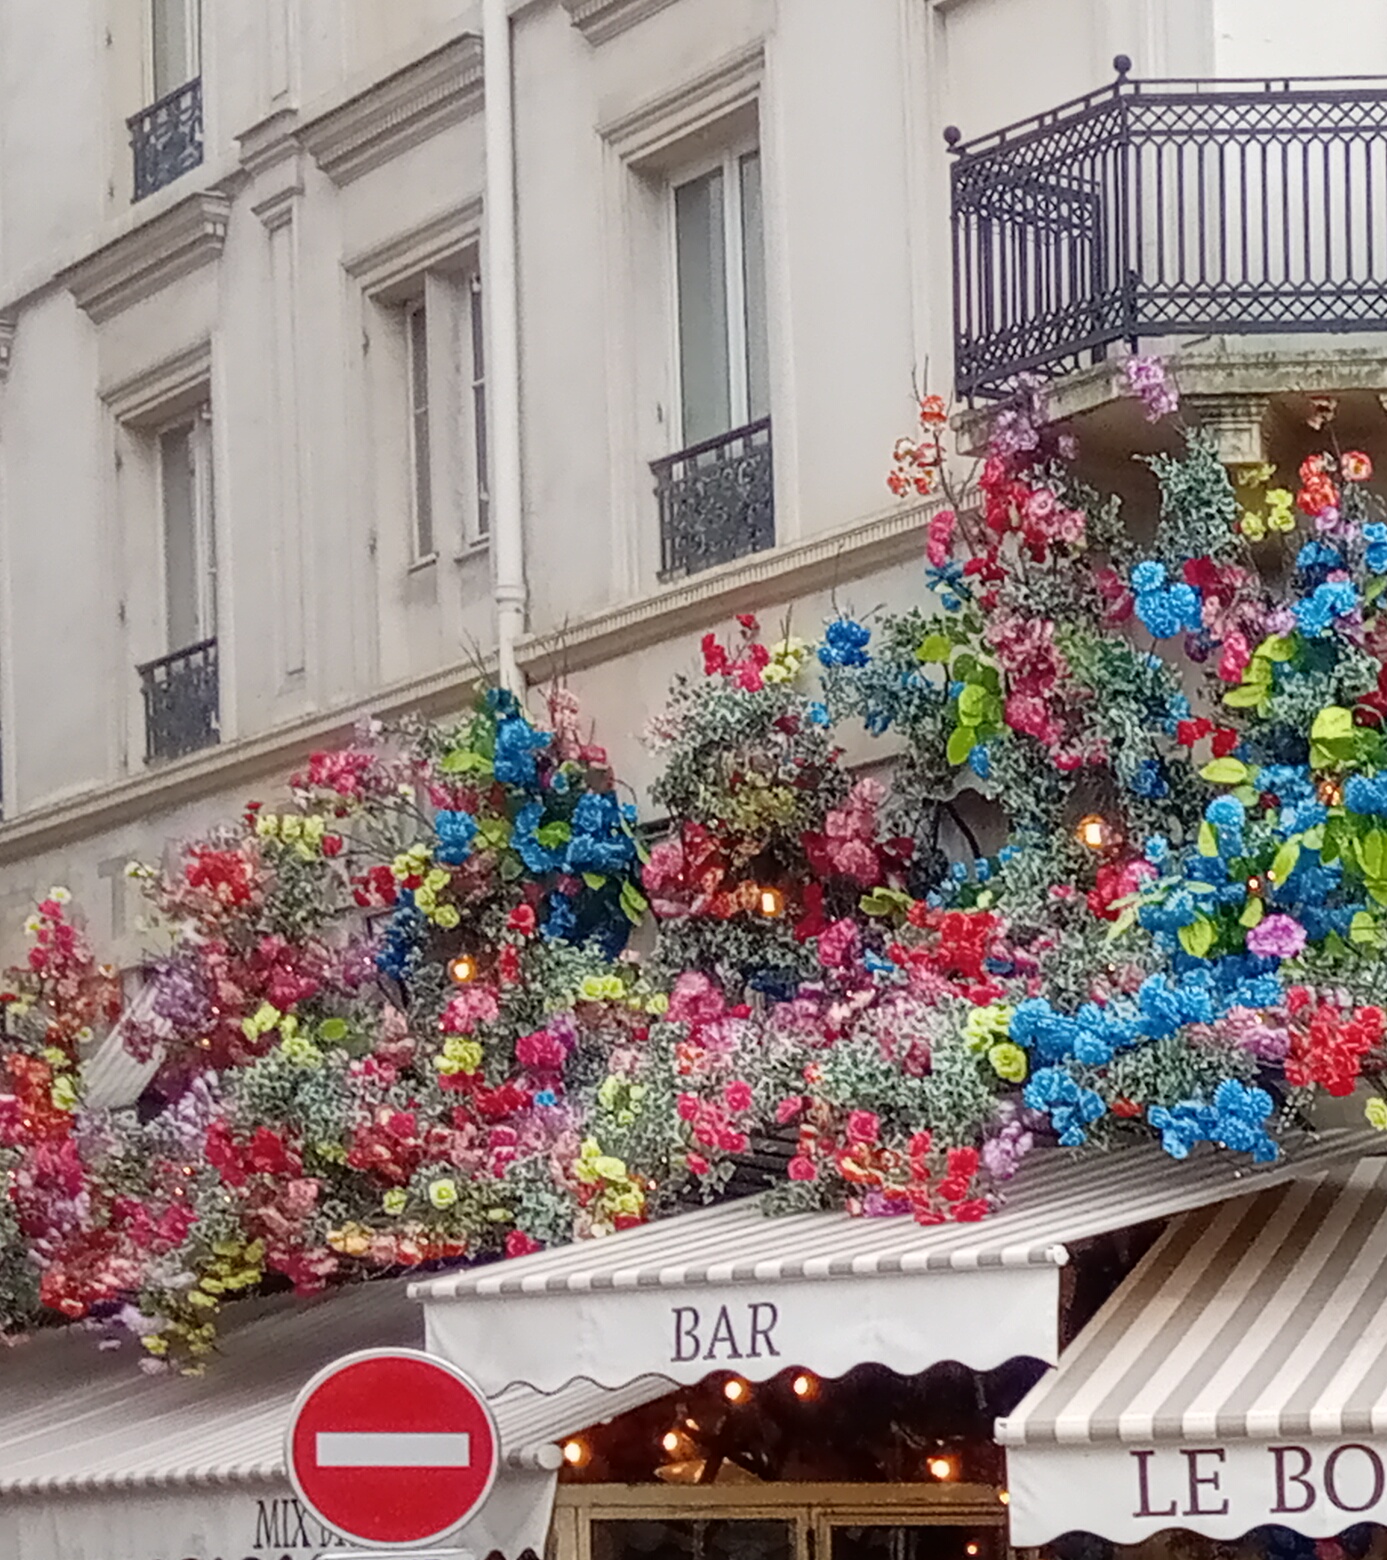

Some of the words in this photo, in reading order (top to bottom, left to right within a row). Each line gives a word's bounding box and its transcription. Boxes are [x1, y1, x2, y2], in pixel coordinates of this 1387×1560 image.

[670, 1302, 781, 1363] BAR
[1129, 1447, 1230, 1517] LE
[253, 1499, 312, 1549] MIX
